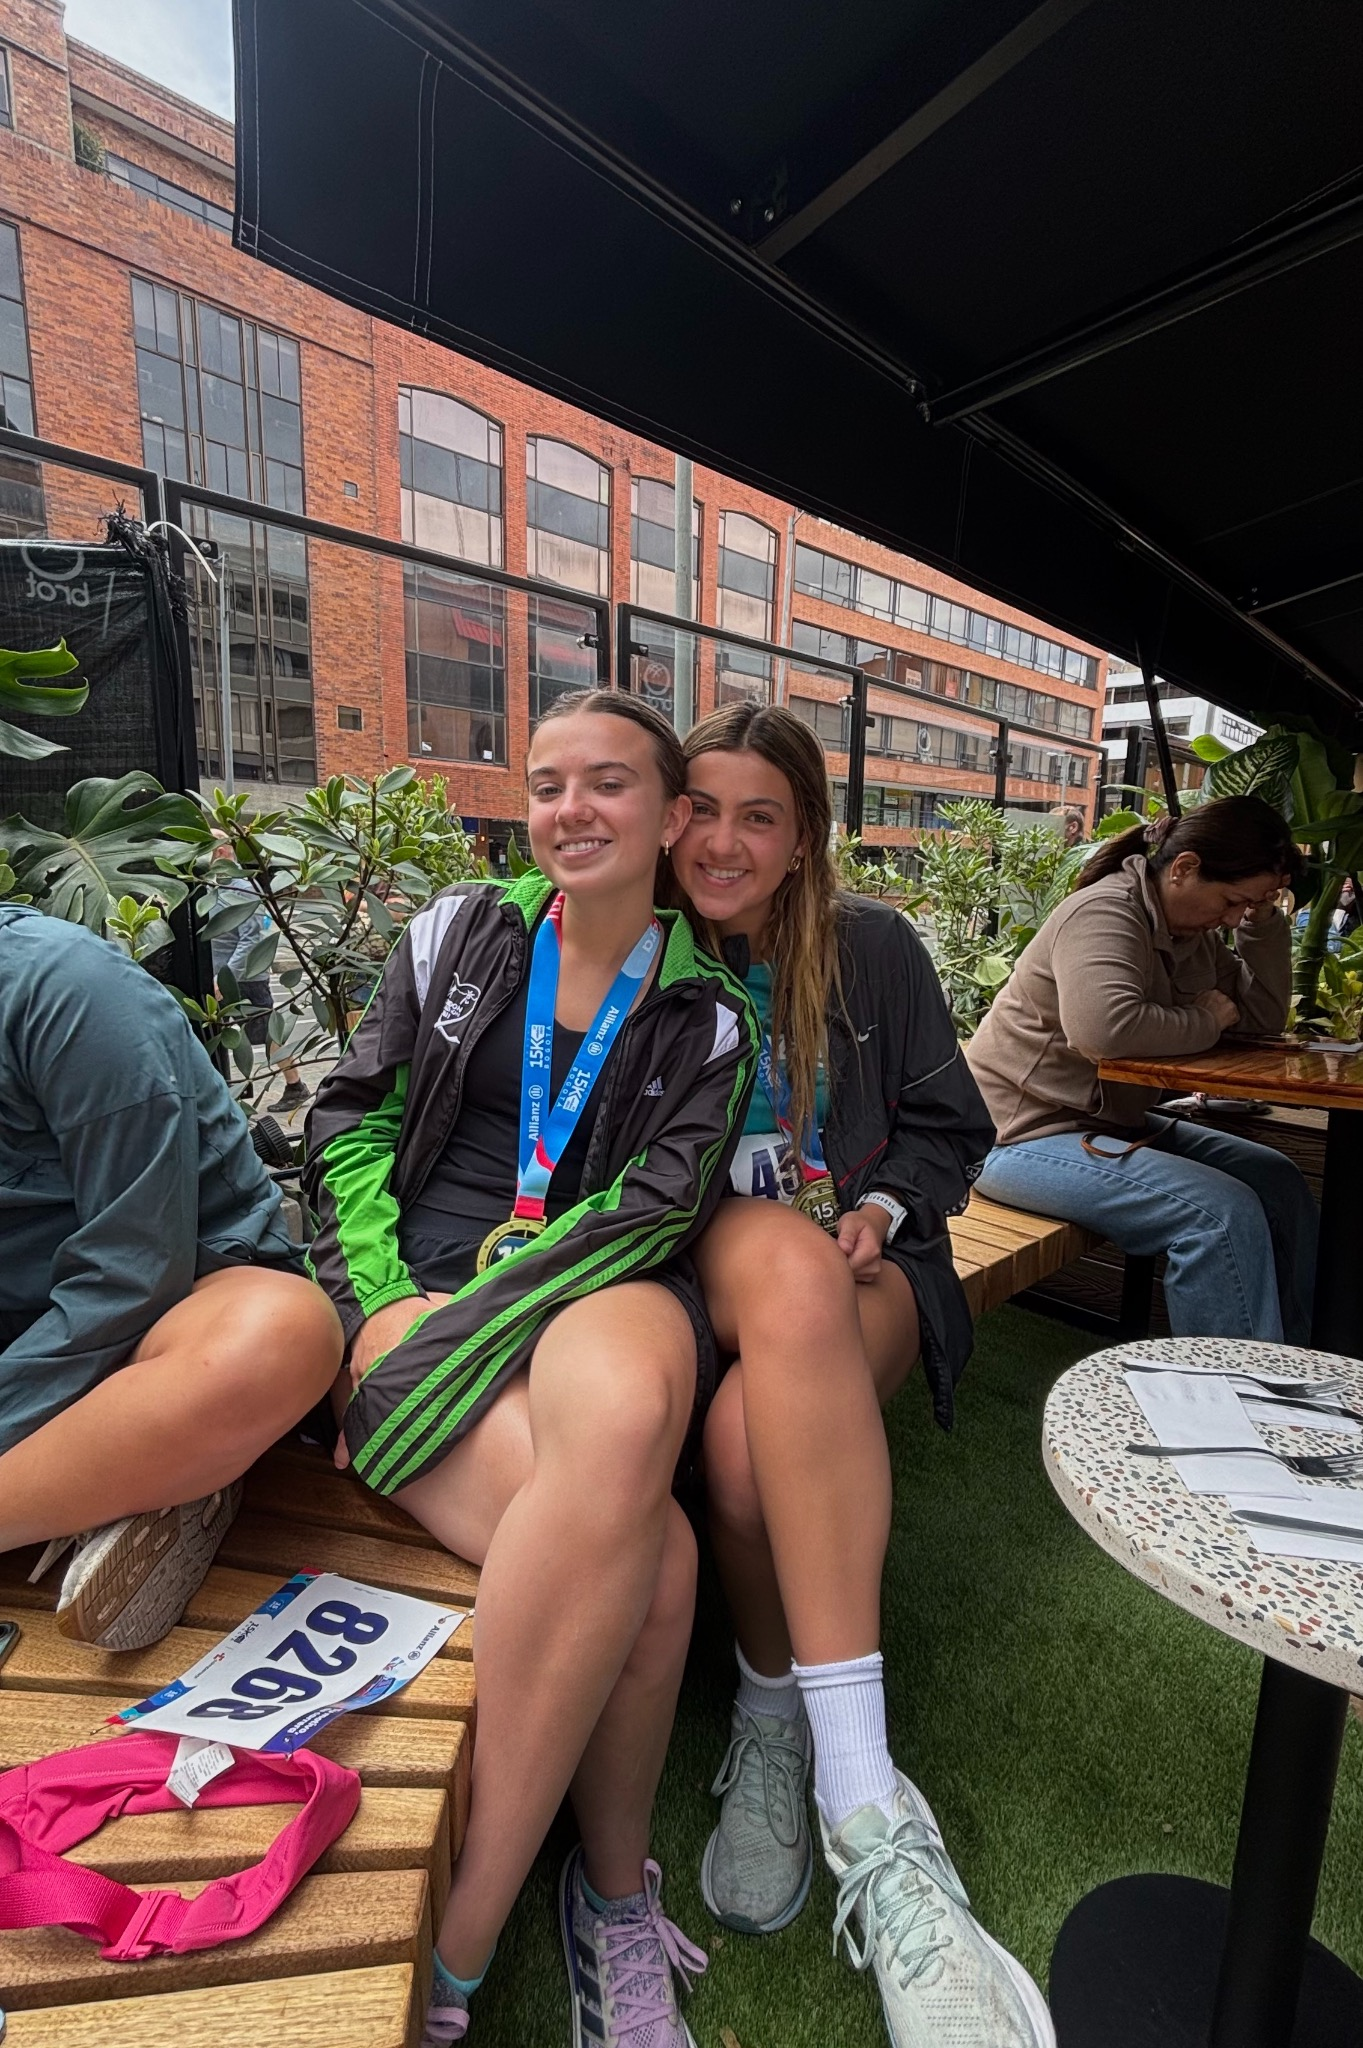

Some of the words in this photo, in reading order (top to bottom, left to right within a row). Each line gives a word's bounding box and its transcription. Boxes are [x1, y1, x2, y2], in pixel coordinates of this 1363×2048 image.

[595, 1005, 620, 1041] Allianz
[529, 1035, 545, 1068] 15K
[543, 1025, 552, 1069] BOGOTA
[556, 1066, 579, 1107] BOGOTA
[568, 1069, 591, 1100] 15K
[528, 1101, 540, 1141] Allianz
[812, 1201, 834, 1220] 15
[415, 1625, 440, 1650] Allianz
[186, 1600, 389, 1721] 8268
